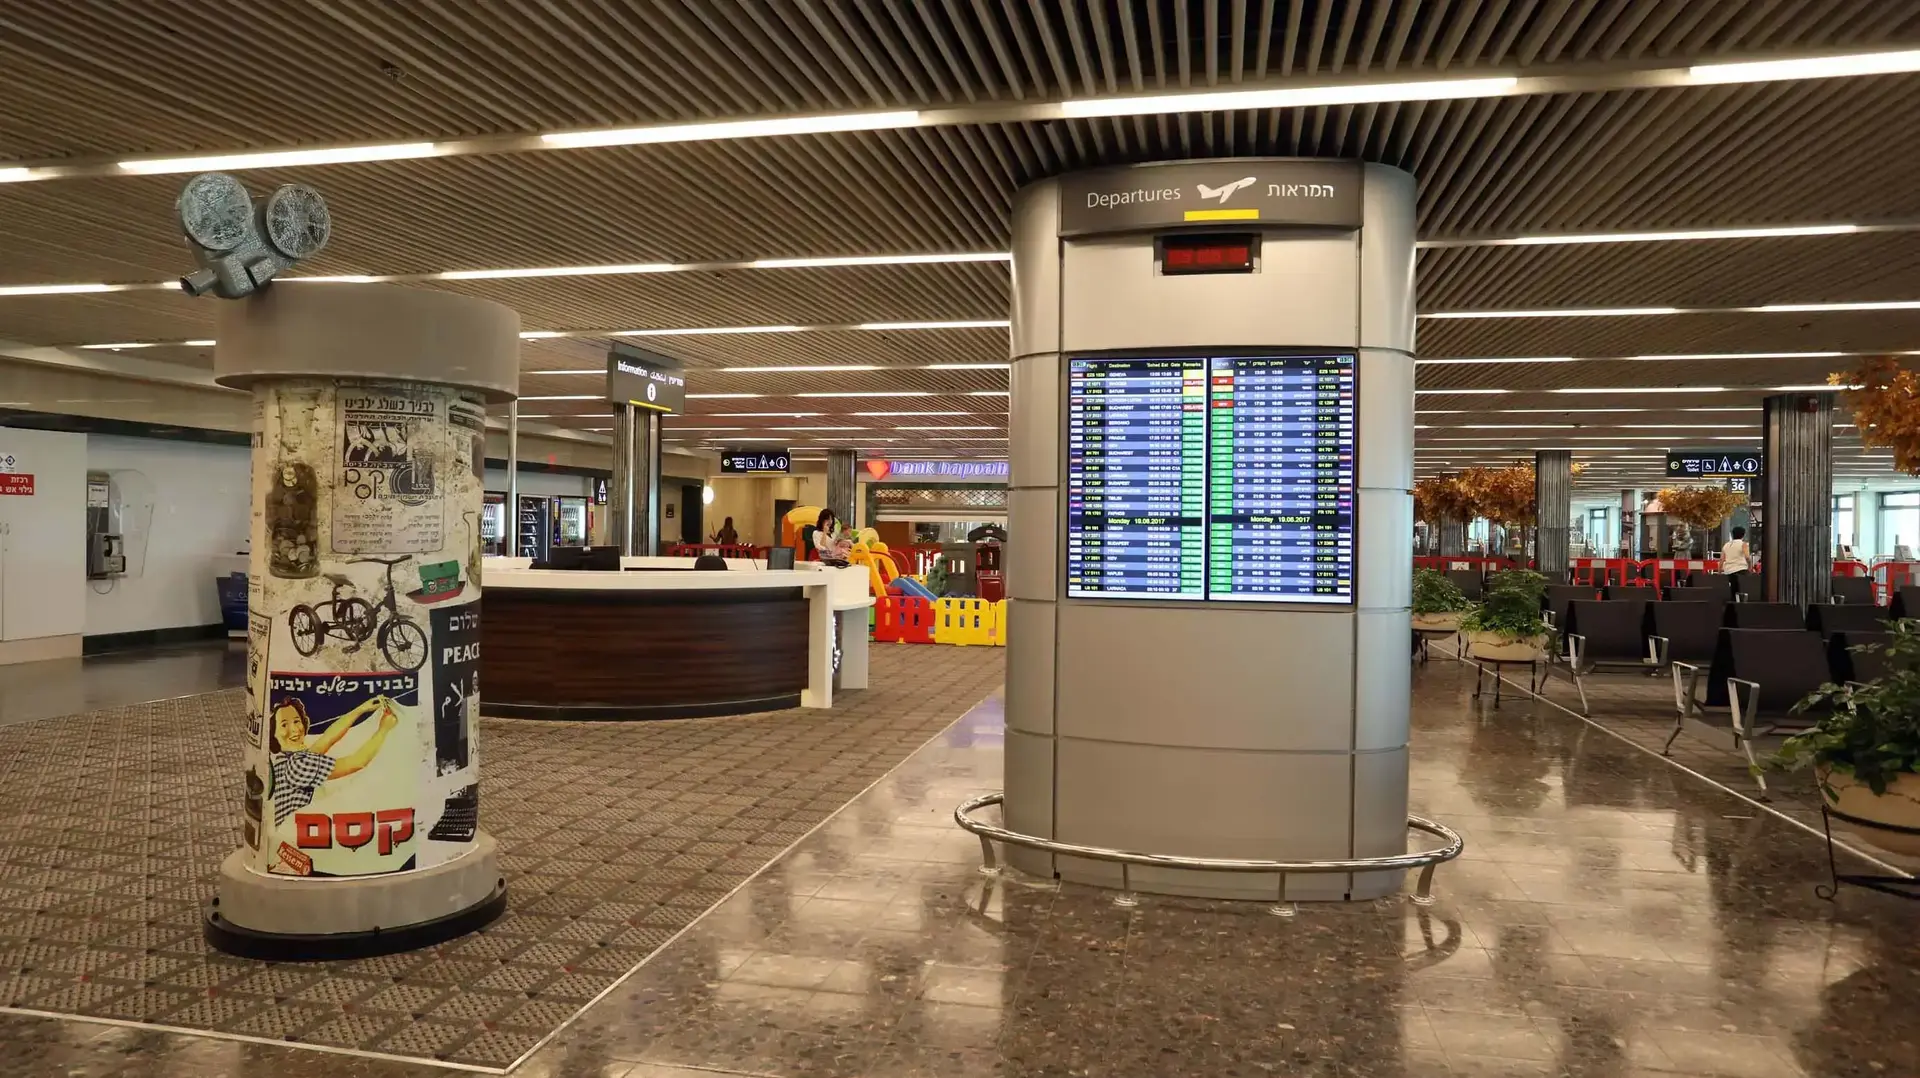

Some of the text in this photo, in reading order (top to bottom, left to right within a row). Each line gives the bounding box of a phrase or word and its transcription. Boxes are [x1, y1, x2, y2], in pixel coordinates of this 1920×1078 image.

[1086, 187, 1181, 208] Departures
[1267, 182, 1334, 198] המראות
[618, 359, 648, 377] Information
[889, 461, 935, 475] bank
[1731, 482, 1746, 491] 36
[1108, 517, 1131, 525] Monday
[1250, 515, 1274, 524] Monday
[270, 675, 414, 696] לבניך כשלג ילבינו
[295, 807, 416, 857] קסם
